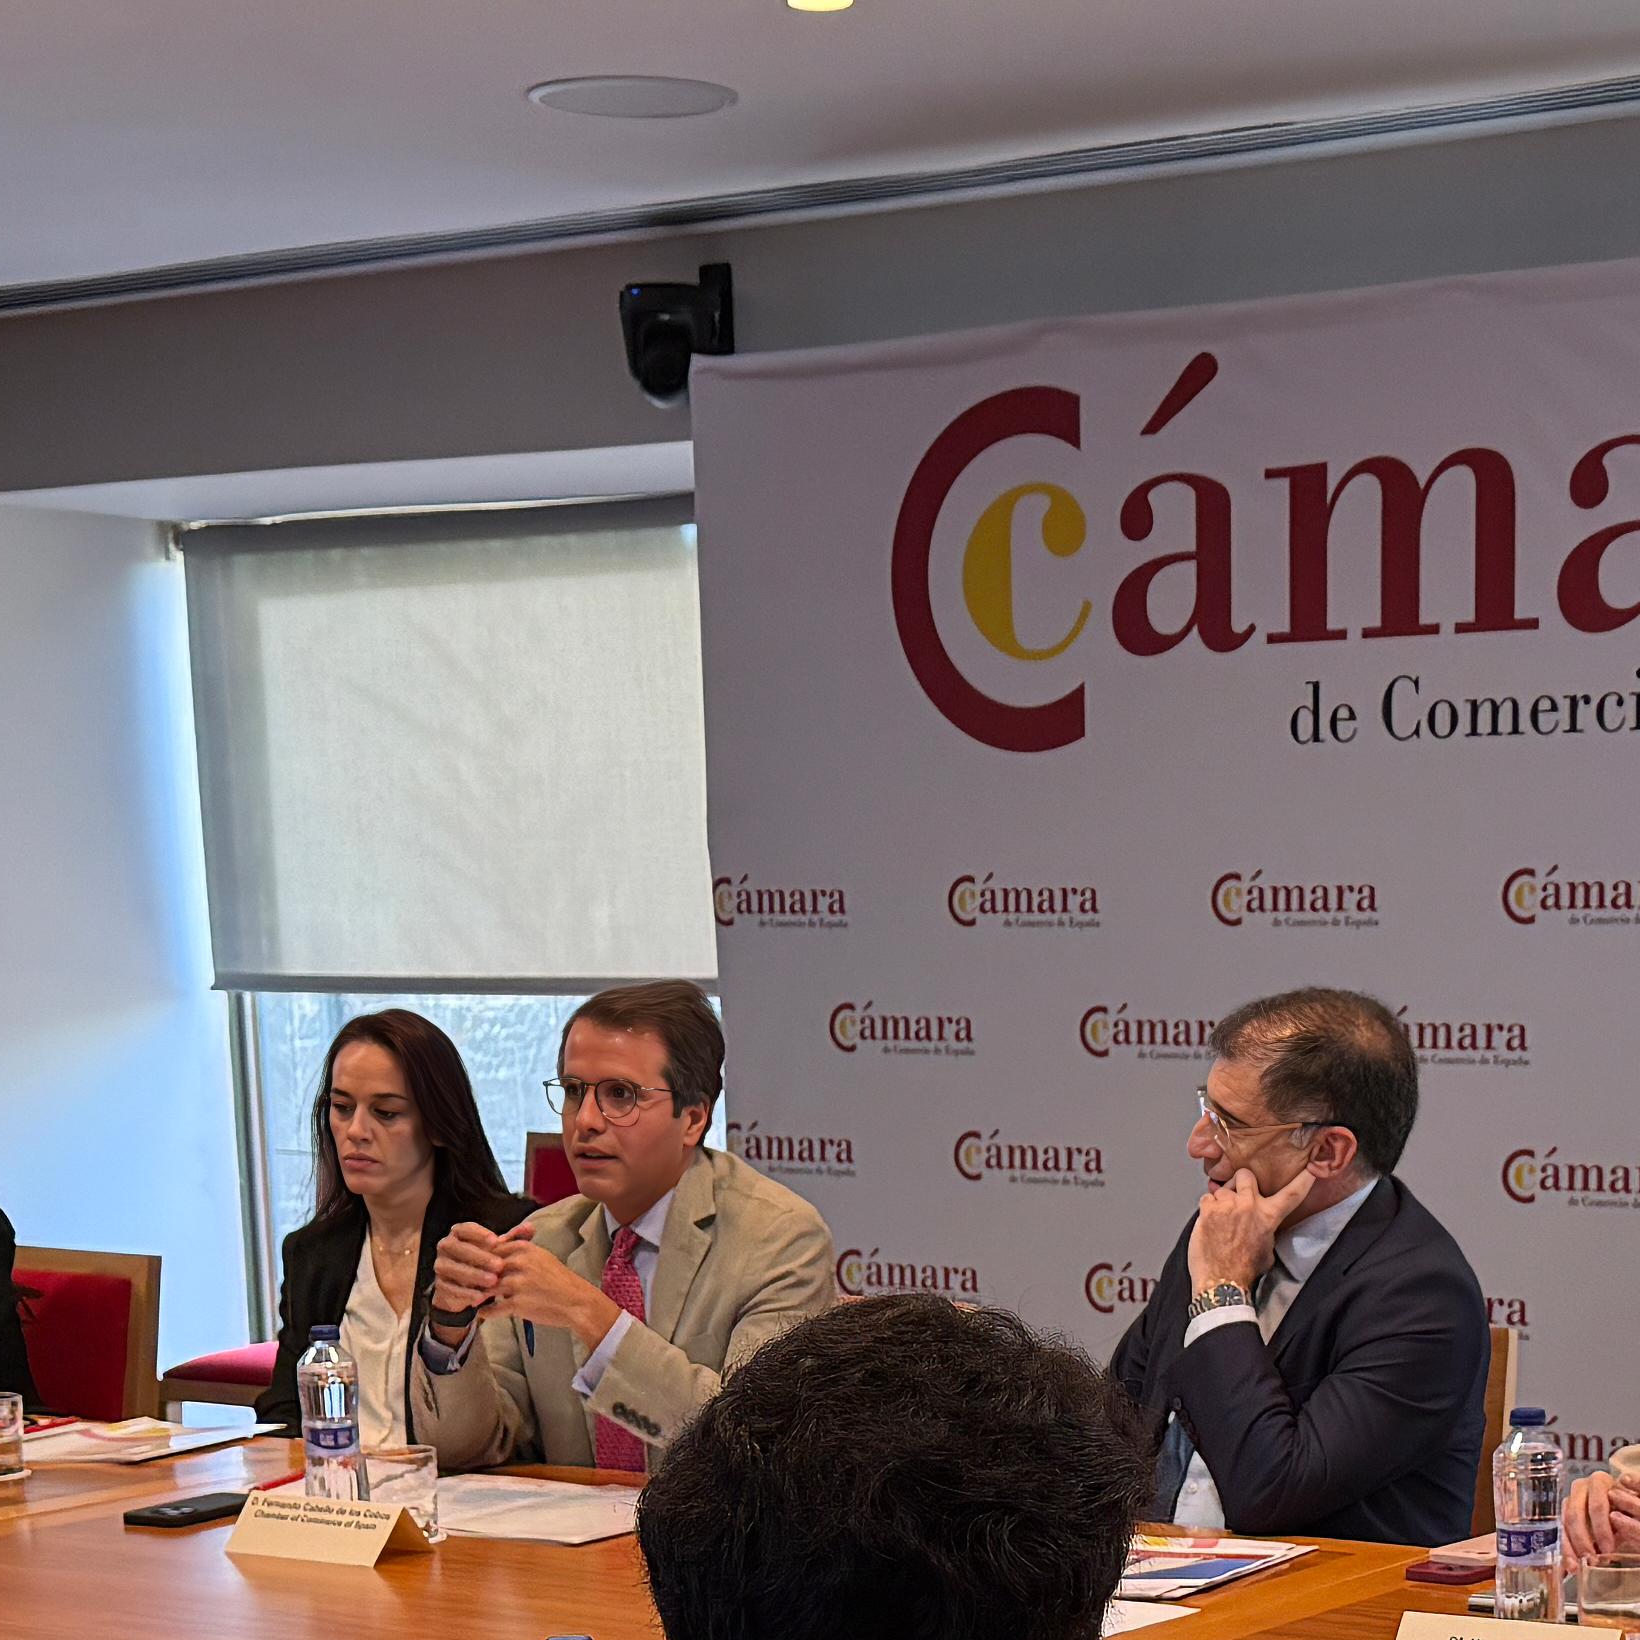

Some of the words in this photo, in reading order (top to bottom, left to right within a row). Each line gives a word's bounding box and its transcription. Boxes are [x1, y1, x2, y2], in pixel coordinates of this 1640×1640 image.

[1290, 681, 1357, 744] de
[948, 872, 1099, 926] Cámara
[1212, 869, 1378, 926] Cámara
[830, 1001, 973, 1052] Cámara
[1080, 1002, 1215, 1057] Cámar
[954, 1129, 1103, 1181] Cámara
[836, 1248, 978, 1296] Cámara
